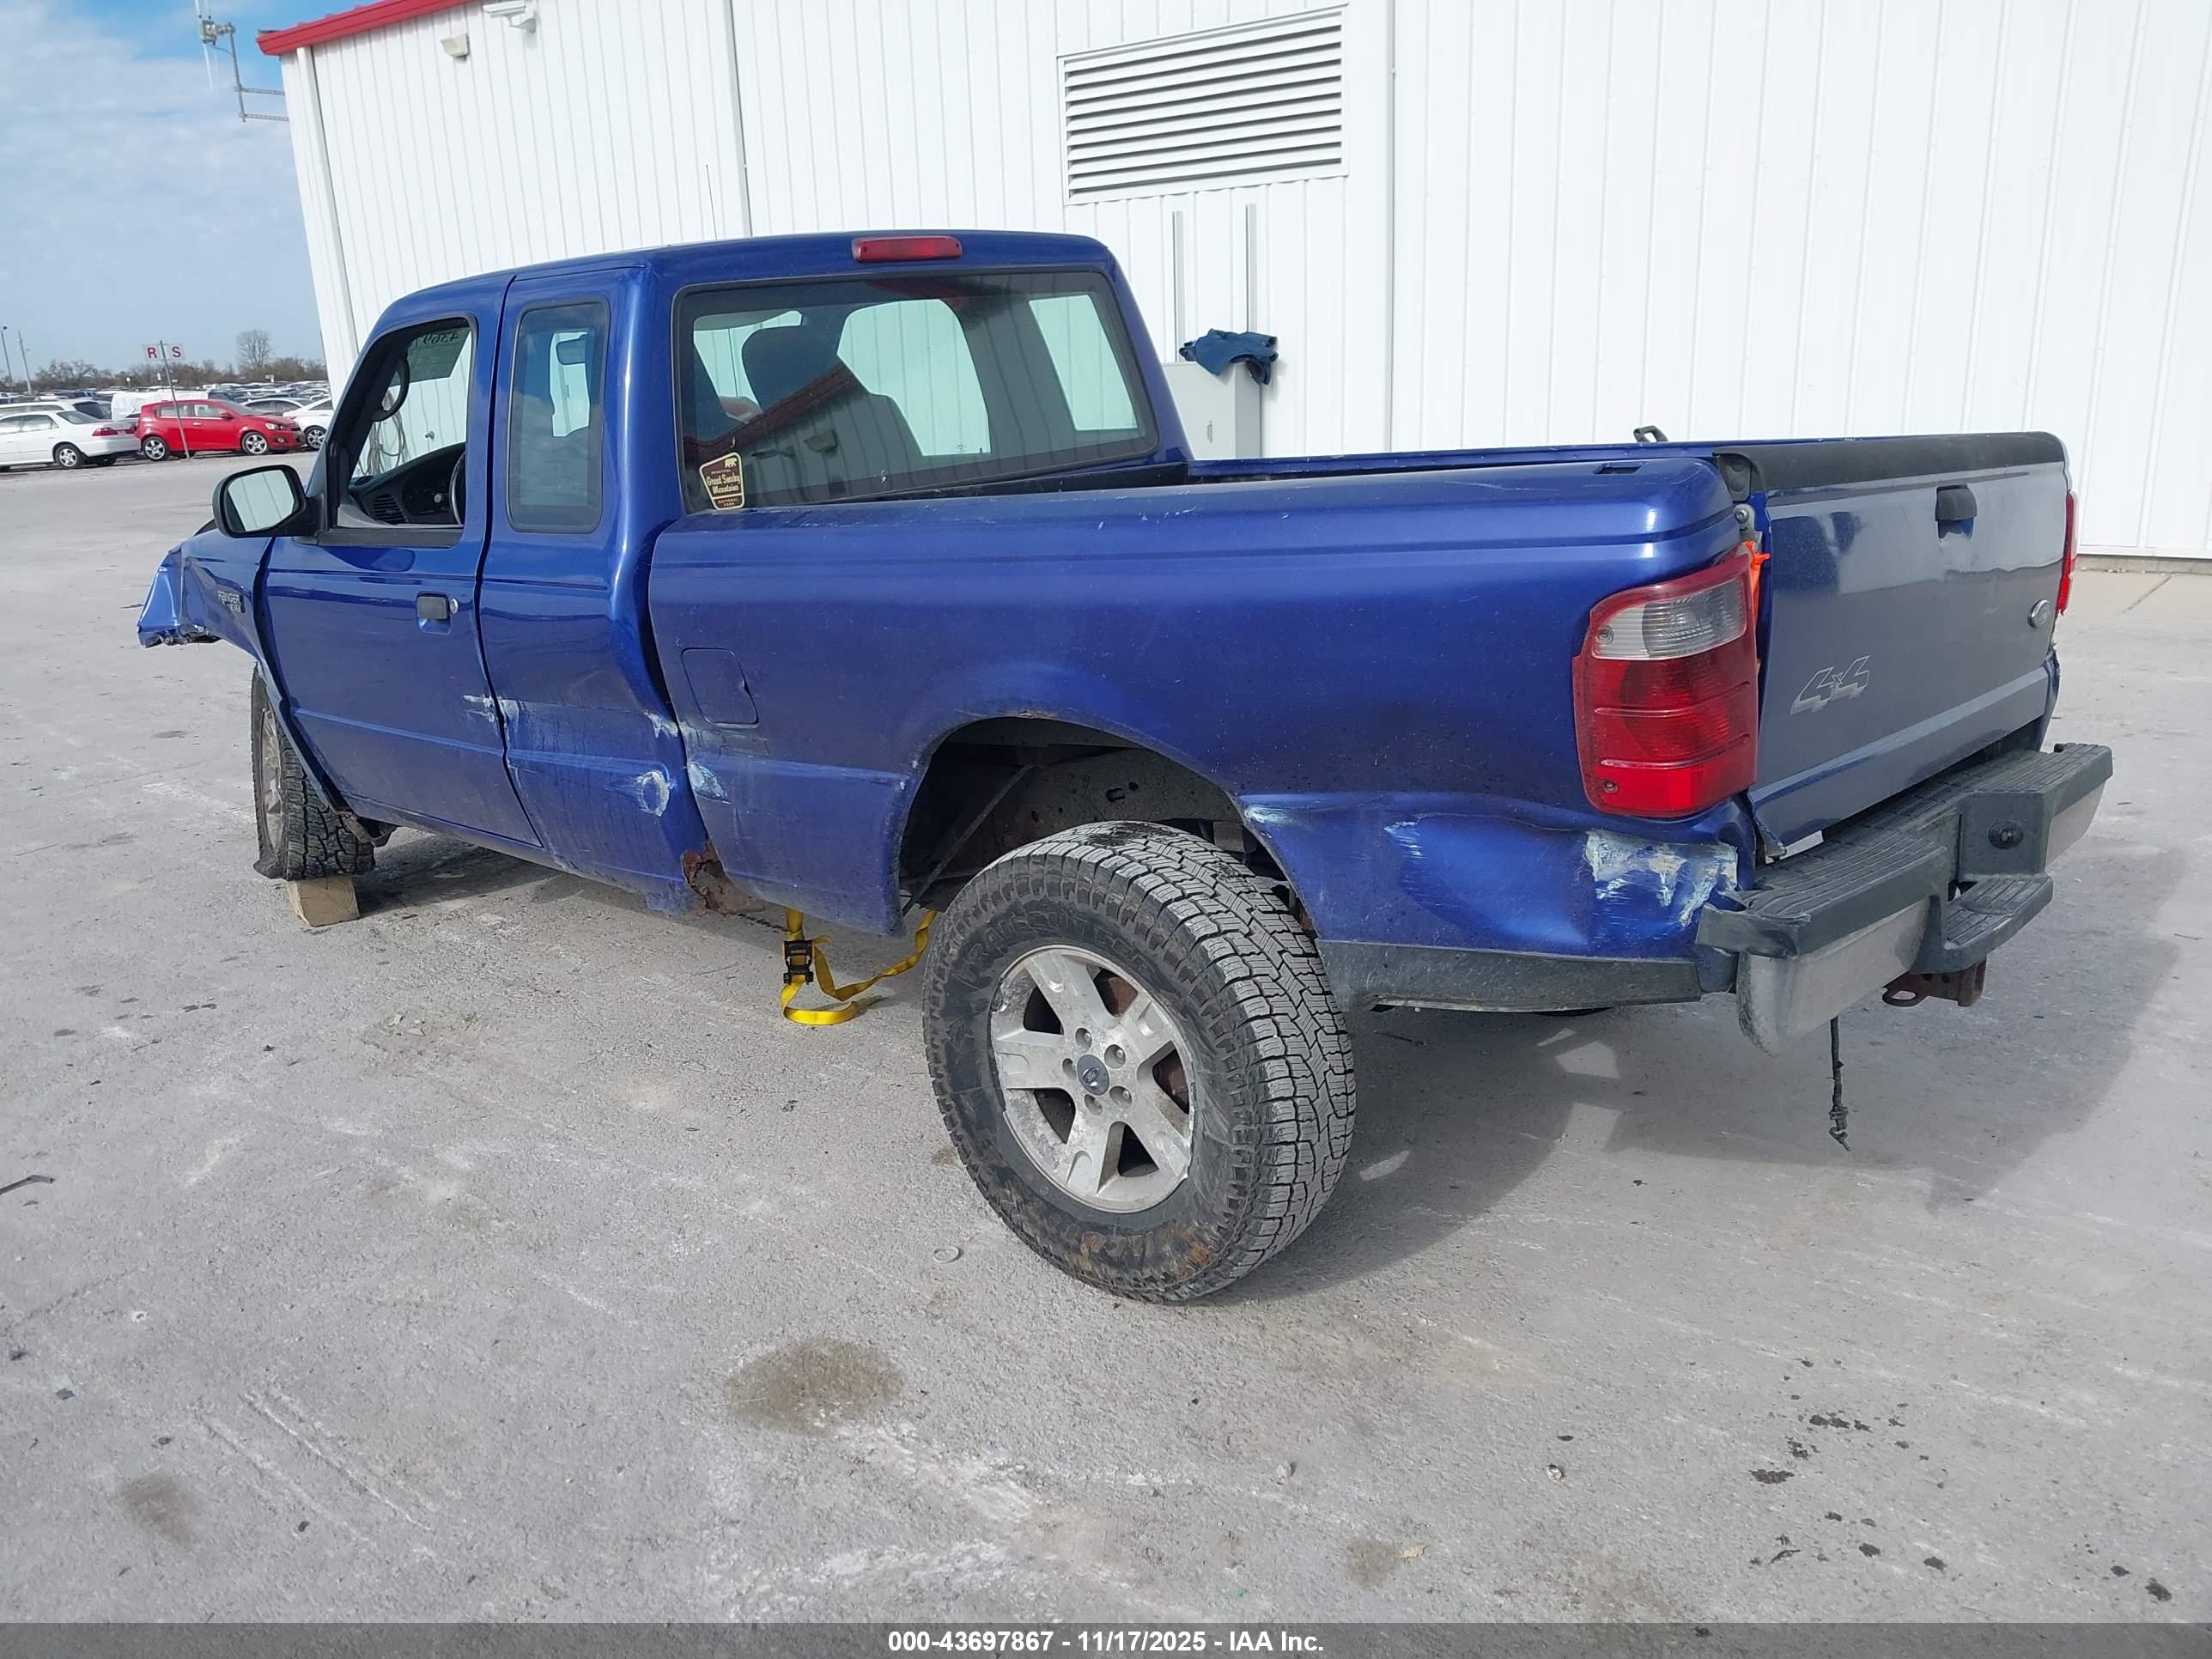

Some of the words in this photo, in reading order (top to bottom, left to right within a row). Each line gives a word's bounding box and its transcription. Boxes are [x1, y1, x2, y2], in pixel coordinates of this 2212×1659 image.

[147, 347, 158, 359] R
[172, 346, 181, 358] S
[706, 473, 723, 487] Great
[712, 483, 739, 495] Mountains
[218, 590, 240, 605] RANGER
